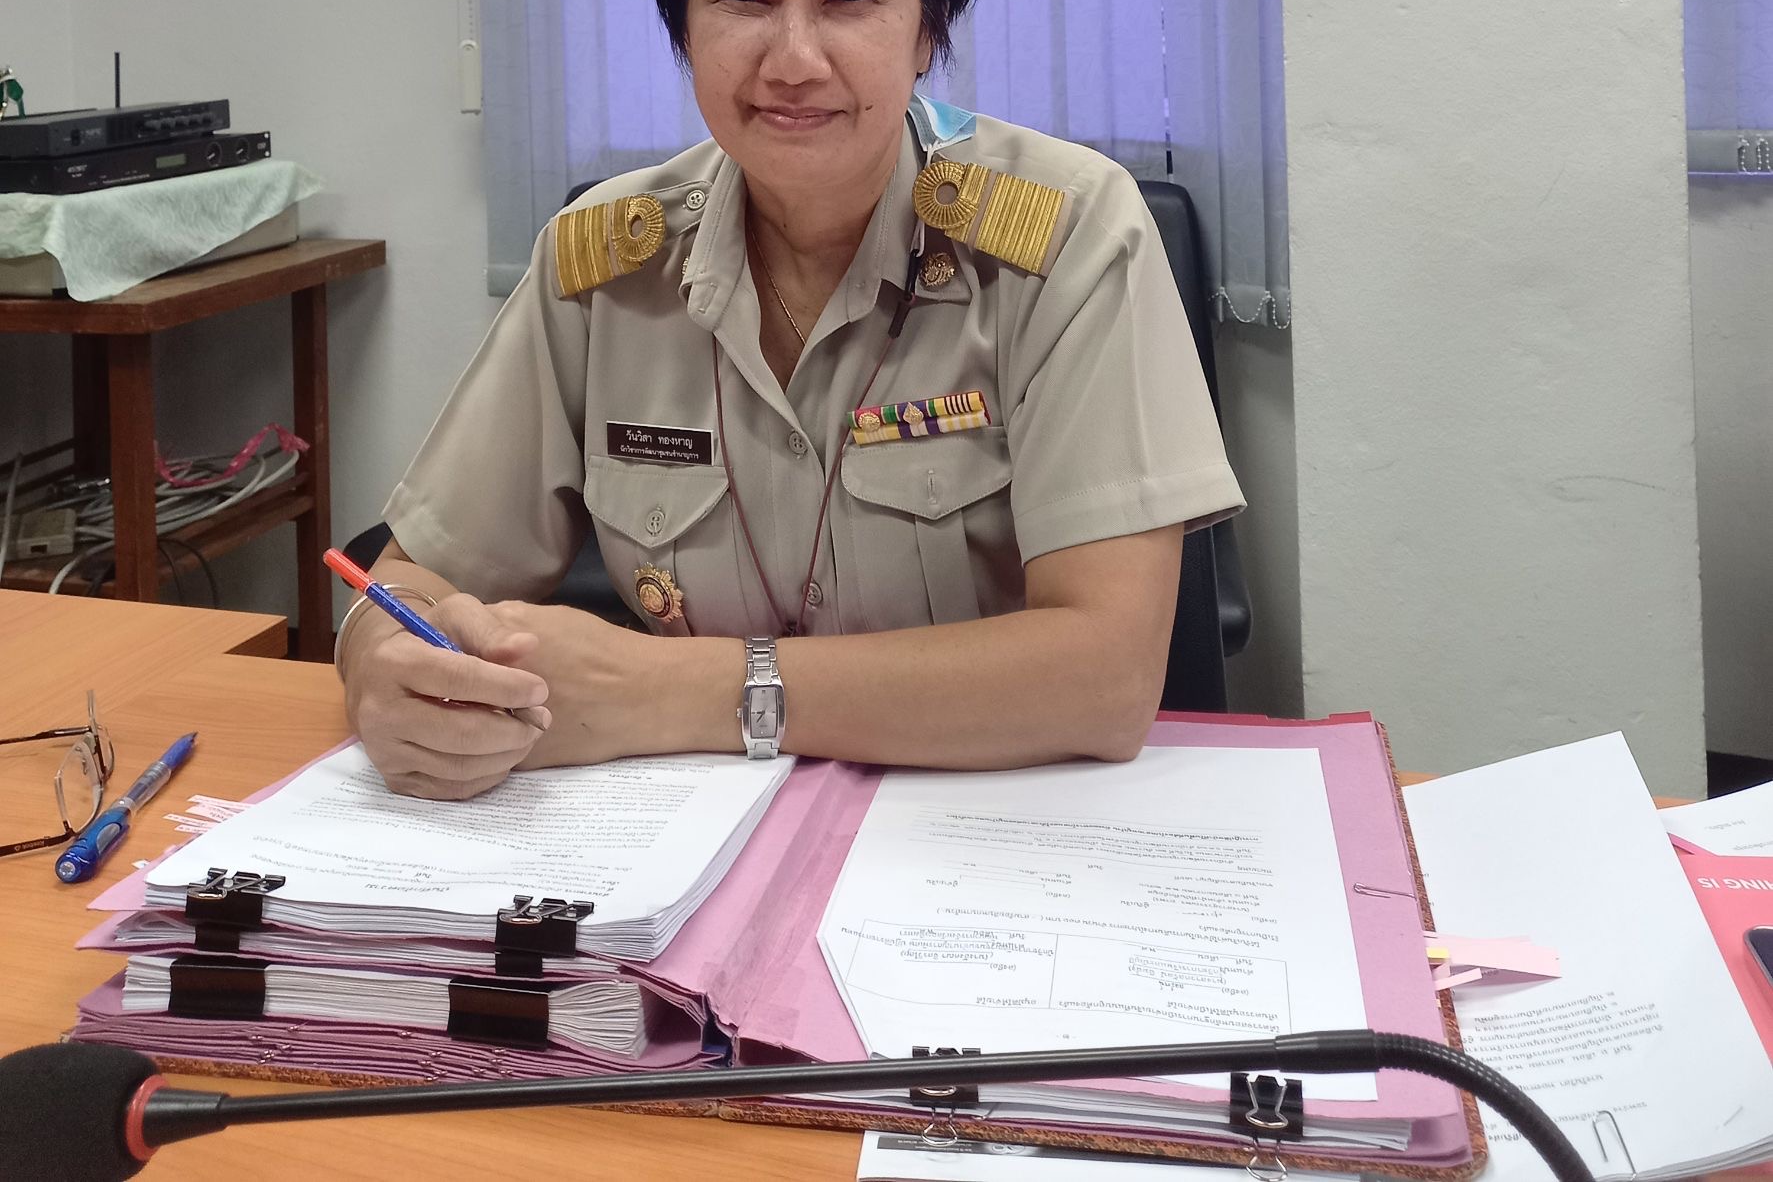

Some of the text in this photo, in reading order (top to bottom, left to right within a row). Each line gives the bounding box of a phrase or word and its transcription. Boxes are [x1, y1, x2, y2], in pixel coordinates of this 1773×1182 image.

[658, 436, 692, 450] ทองหาญ
[1697, 877, 1720, 889] IS
